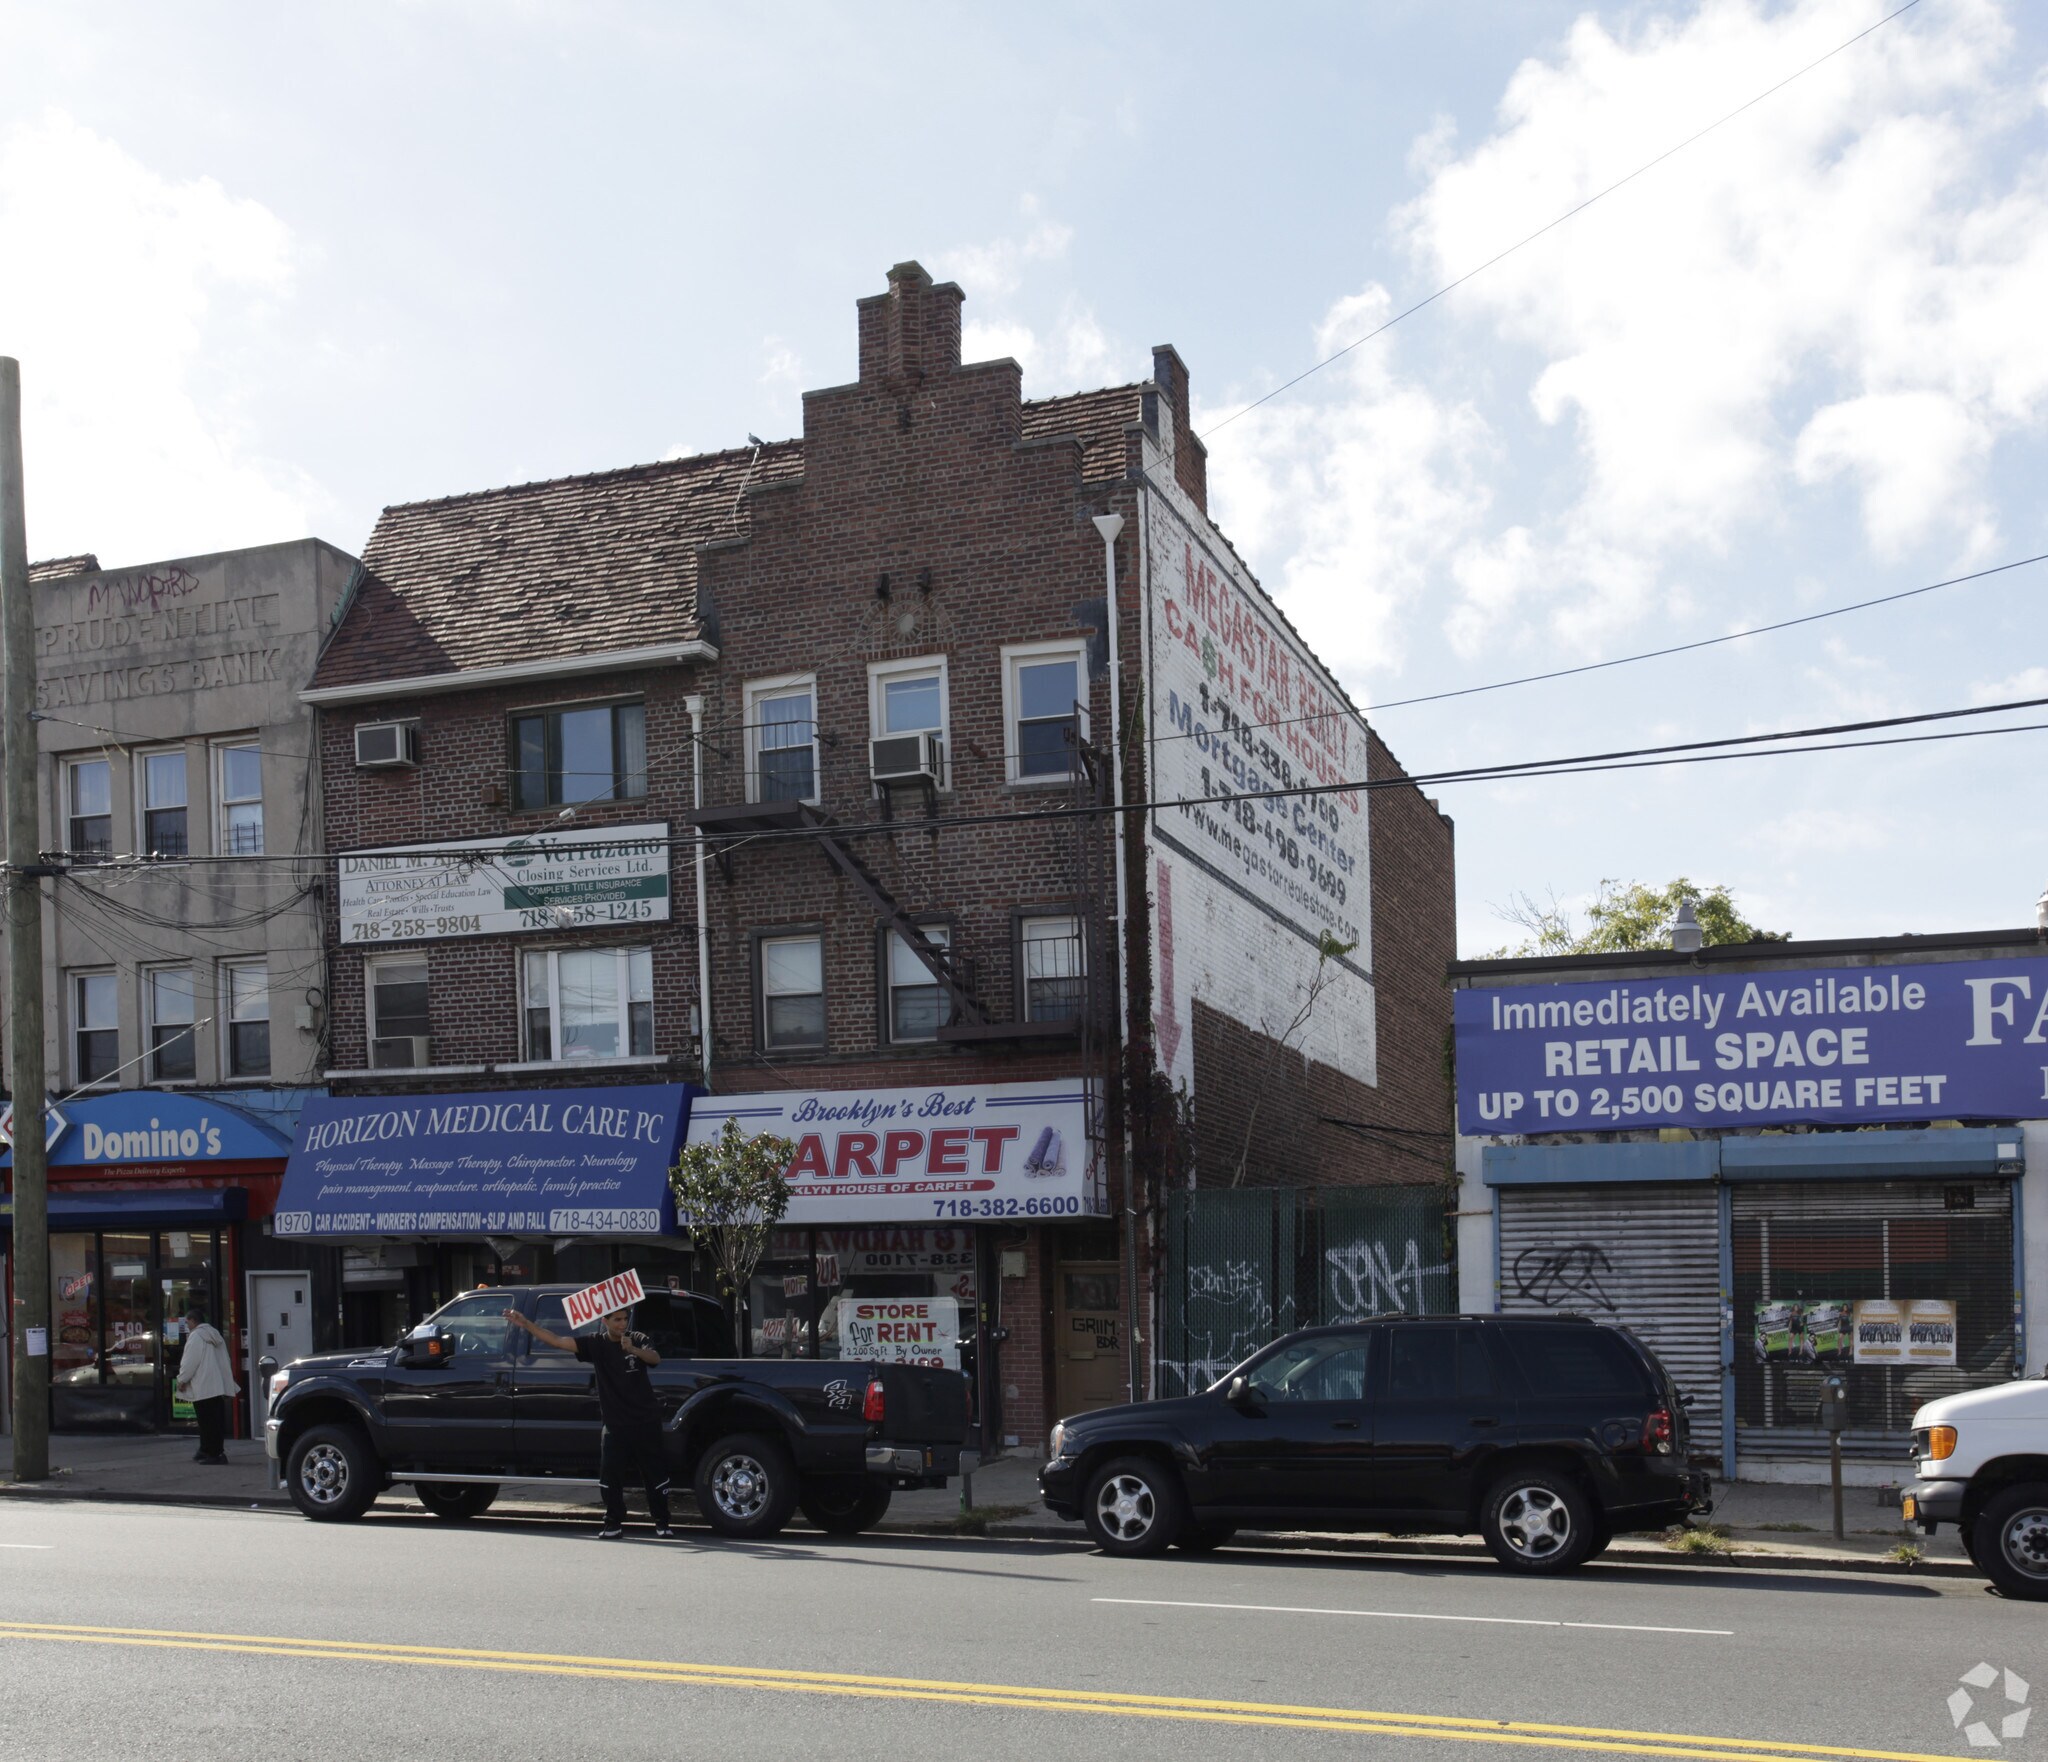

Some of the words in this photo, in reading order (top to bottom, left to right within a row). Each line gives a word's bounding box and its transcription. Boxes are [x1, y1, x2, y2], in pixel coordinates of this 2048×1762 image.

[42, 594, 271, 656] PRUDENTIAL
[1184, 542, 1291, 713] MEGASTAR
[1299, 671, 1348, 769] REALTY
[36, 664, 175, 709] SAVINGS
[191, 649, 275, 690] BANK
[1240, 674, 1283, 742] FOR
[1286, 718, 1359, 815] HOUSES
[1169, 688, 1288, 819] Mortgage
[1293, 803, 1356, 877] Center
[1200, 766, 1347, 906] 1-718-490-9699
[366, 878, 425, 892] ATTORNEY
[445, 874, 469, 886] LAW
[517, 869, 564, 883] Closing
[569, 863, 621, 878] Services
[627, 859, 653, 874] Ltd.
[342, 898, 366, 907] Health
[415, 892, 440, 903] Special
[441, 888, 476, 900] Education
[477, 887, 493, 896] Law
[527, 884, 570, 896] COMPLETE
[572, 882, 594, 892] TITLE
[596, 878, 642, 890] INSURANCE
[543, 894, 583, 907] SERVICES
[584, 891, 627, 903] PROVIDED
[367, 909, 383, 918] Real
[411, 905, 429, 914] Wills
[433, 903, 455, 913] Trusts
[519, 900, 652, 928] 718-58-1245
[352, 914, 482, 941] 718-258-9804
[1492, 983, 1726, 1030] Immediately
[1736, 974, 1926, 1019] Available
[1544, 1035, 1700, 1077] RETAIL
[1714, 1027, 1870, 1071] SPACE
[791, 1097, 914, 1128] Brooklyn's
[917, 1091, 977, 1117] Best
[1478, 1091, 1525, 1120] UP
[1533, 1088, 1580, 1118] TO
[1590, 1084, 1684, 1122] 2,500
[1694, 1078, 1843, 1113] SQUARE
[1855, 1074, 1948, 1107] FEET
[83, 1117, 222, 1160] Domino's
[303, 1109, 422, 1153] HORIZON
[424, 1103, 554, 1136] MEDICAL
[562, 1104, 630, 1138] CARE
[633, 1111, 664, 1144] PC
[104, 1168, 115, 1176] The
[116, 1168, 134, 1176] Pizza
[134, 1167, 161, 1176] Delivery
[161, 1166, 186, 1175] Experts
[314, 1158, 362, 1178] Physical
[409, 1157, 454, 1176] Massage
[580, 1151, 638, 1172] Neurology
[316, 1184, 343, 1200] pain
[540, 1176, 578, 1198] family
[576, 1179, 622, 1197] practice
[835, 1184, 887, 1195] HOUSE
[890, 1182, 911, 1193] OF
[914, 1181, 975, 1192] CARPET
[933, 1196, 1079, 1217] 718-382-6600
[277, 1213, 311, 1232] 1970
[314, 1213, 331, 1231] CAR
[331, 1213, 371, 1230] ACCIDENT
[376, 1212, 417, 1230] WORKER'S
[418, 1211, 482, 1230] COMPENSATION
[487, 1212, 506, 1230] SLIP
[507, 1211, 525, 1230] AND
[526, 1211, 546, 1230] FALL
[552, 1210, 657, 1230] 718-434-0830
[64, 1272, 94, 1296] OPEN
[568, 1270, 642, 1326] AUCTION
[856, 1304, 929, 1320] STORE
[877, 1322, 937, 1343] RENT
[895, 1345, 907, 1359] By
[911, 1345, 942, 1355] Owner
